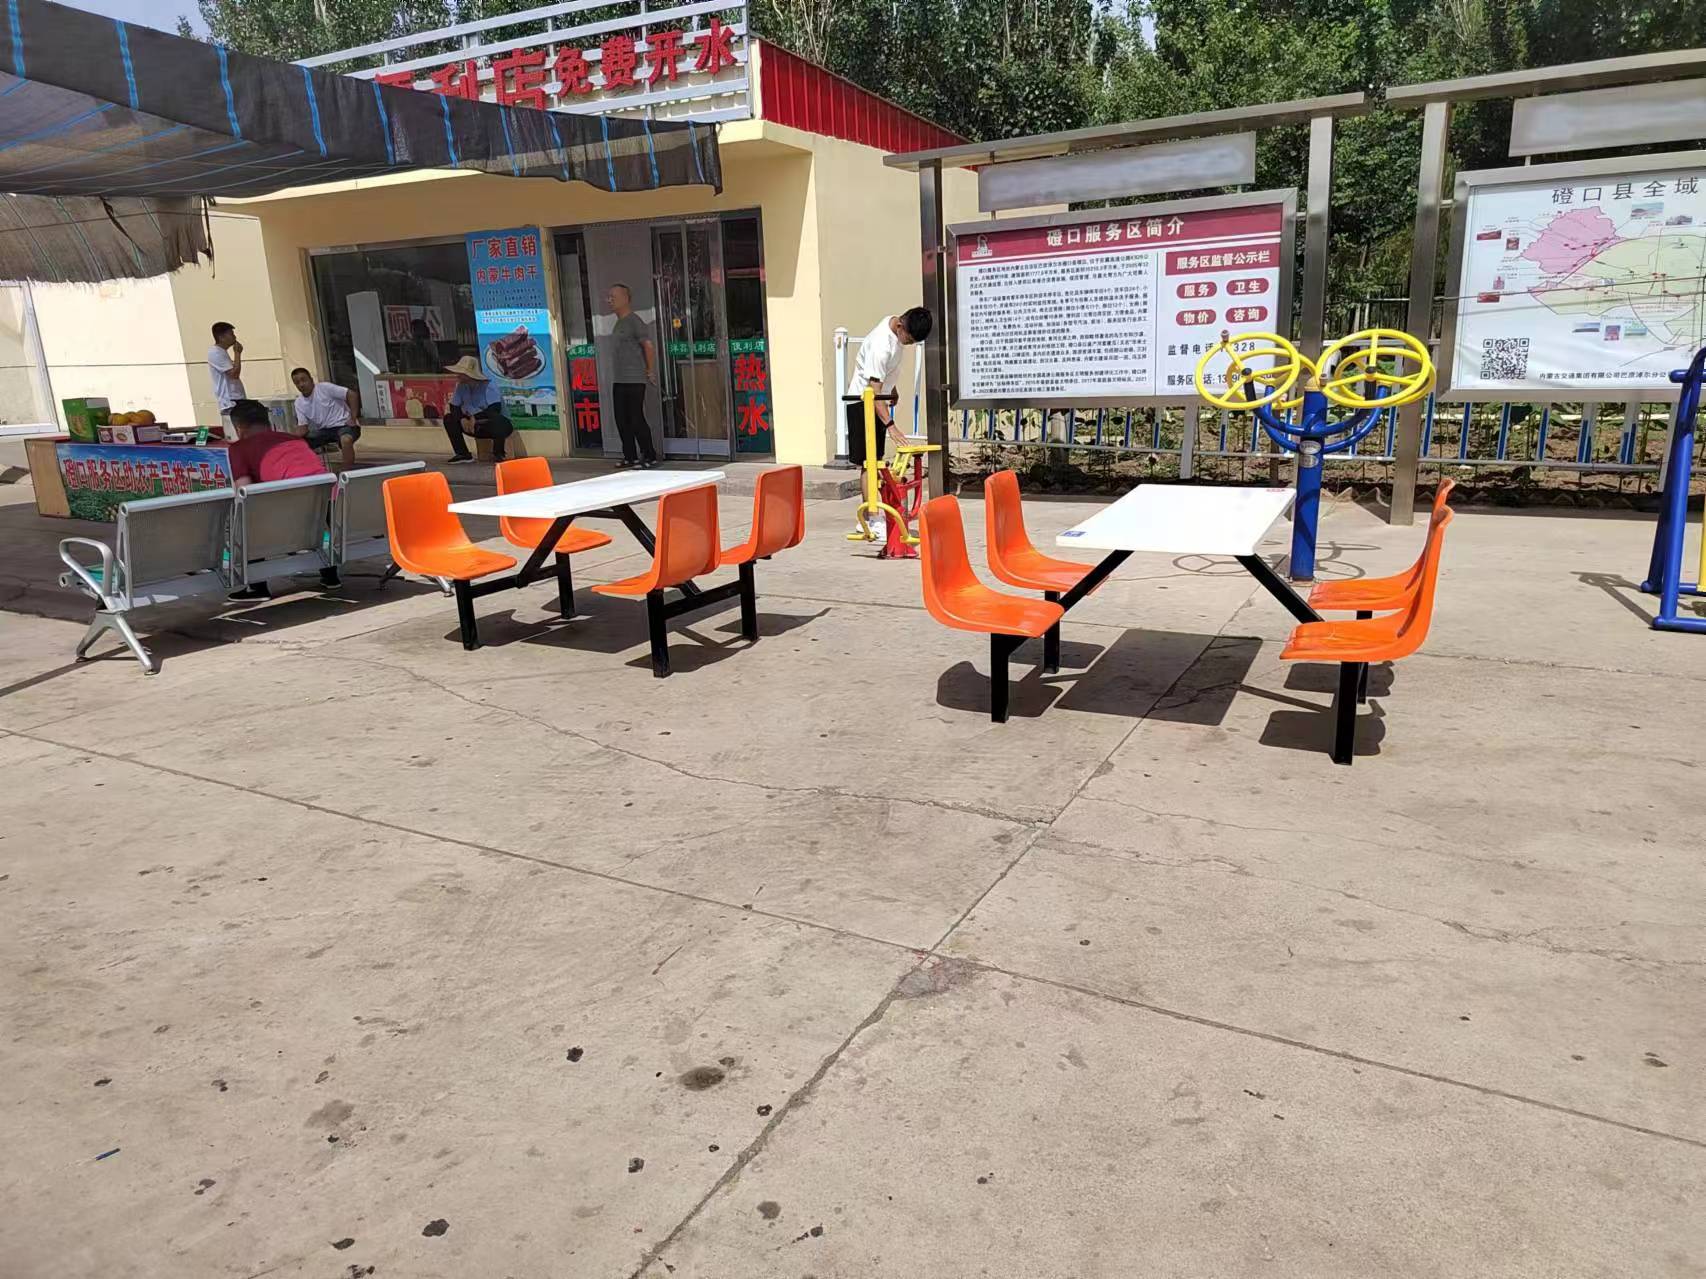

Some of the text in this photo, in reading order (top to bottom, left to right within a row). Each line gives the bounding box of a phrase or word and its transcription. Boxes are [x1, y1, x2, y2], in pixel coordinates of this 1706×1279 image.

[1551, 177, 1698, 204] 磴口县全域
[1047, 216, 1185, 247] 磴口服务区简介
[471, 235, 537, 259] 厂家直销
[1176, 249, 1270, 270] 服务区监督公示栏
[476, 266, 537, 286] 内蒙牛肉干
[1184, 284, 1210, 297] 服务
[1234, 280, 1261, 293] 卫生
[1183, 311, 1209, 324] 物价
[1233, 308, 1260, 321] 咨询
[1539, 371, 1669, 380] 内蒙古交通集团有限公司巴彦淖尔分公
[733, 352, 769, 436] 热水
[63, 458, 226, 494] 磴口服务区助农产品推广平台
